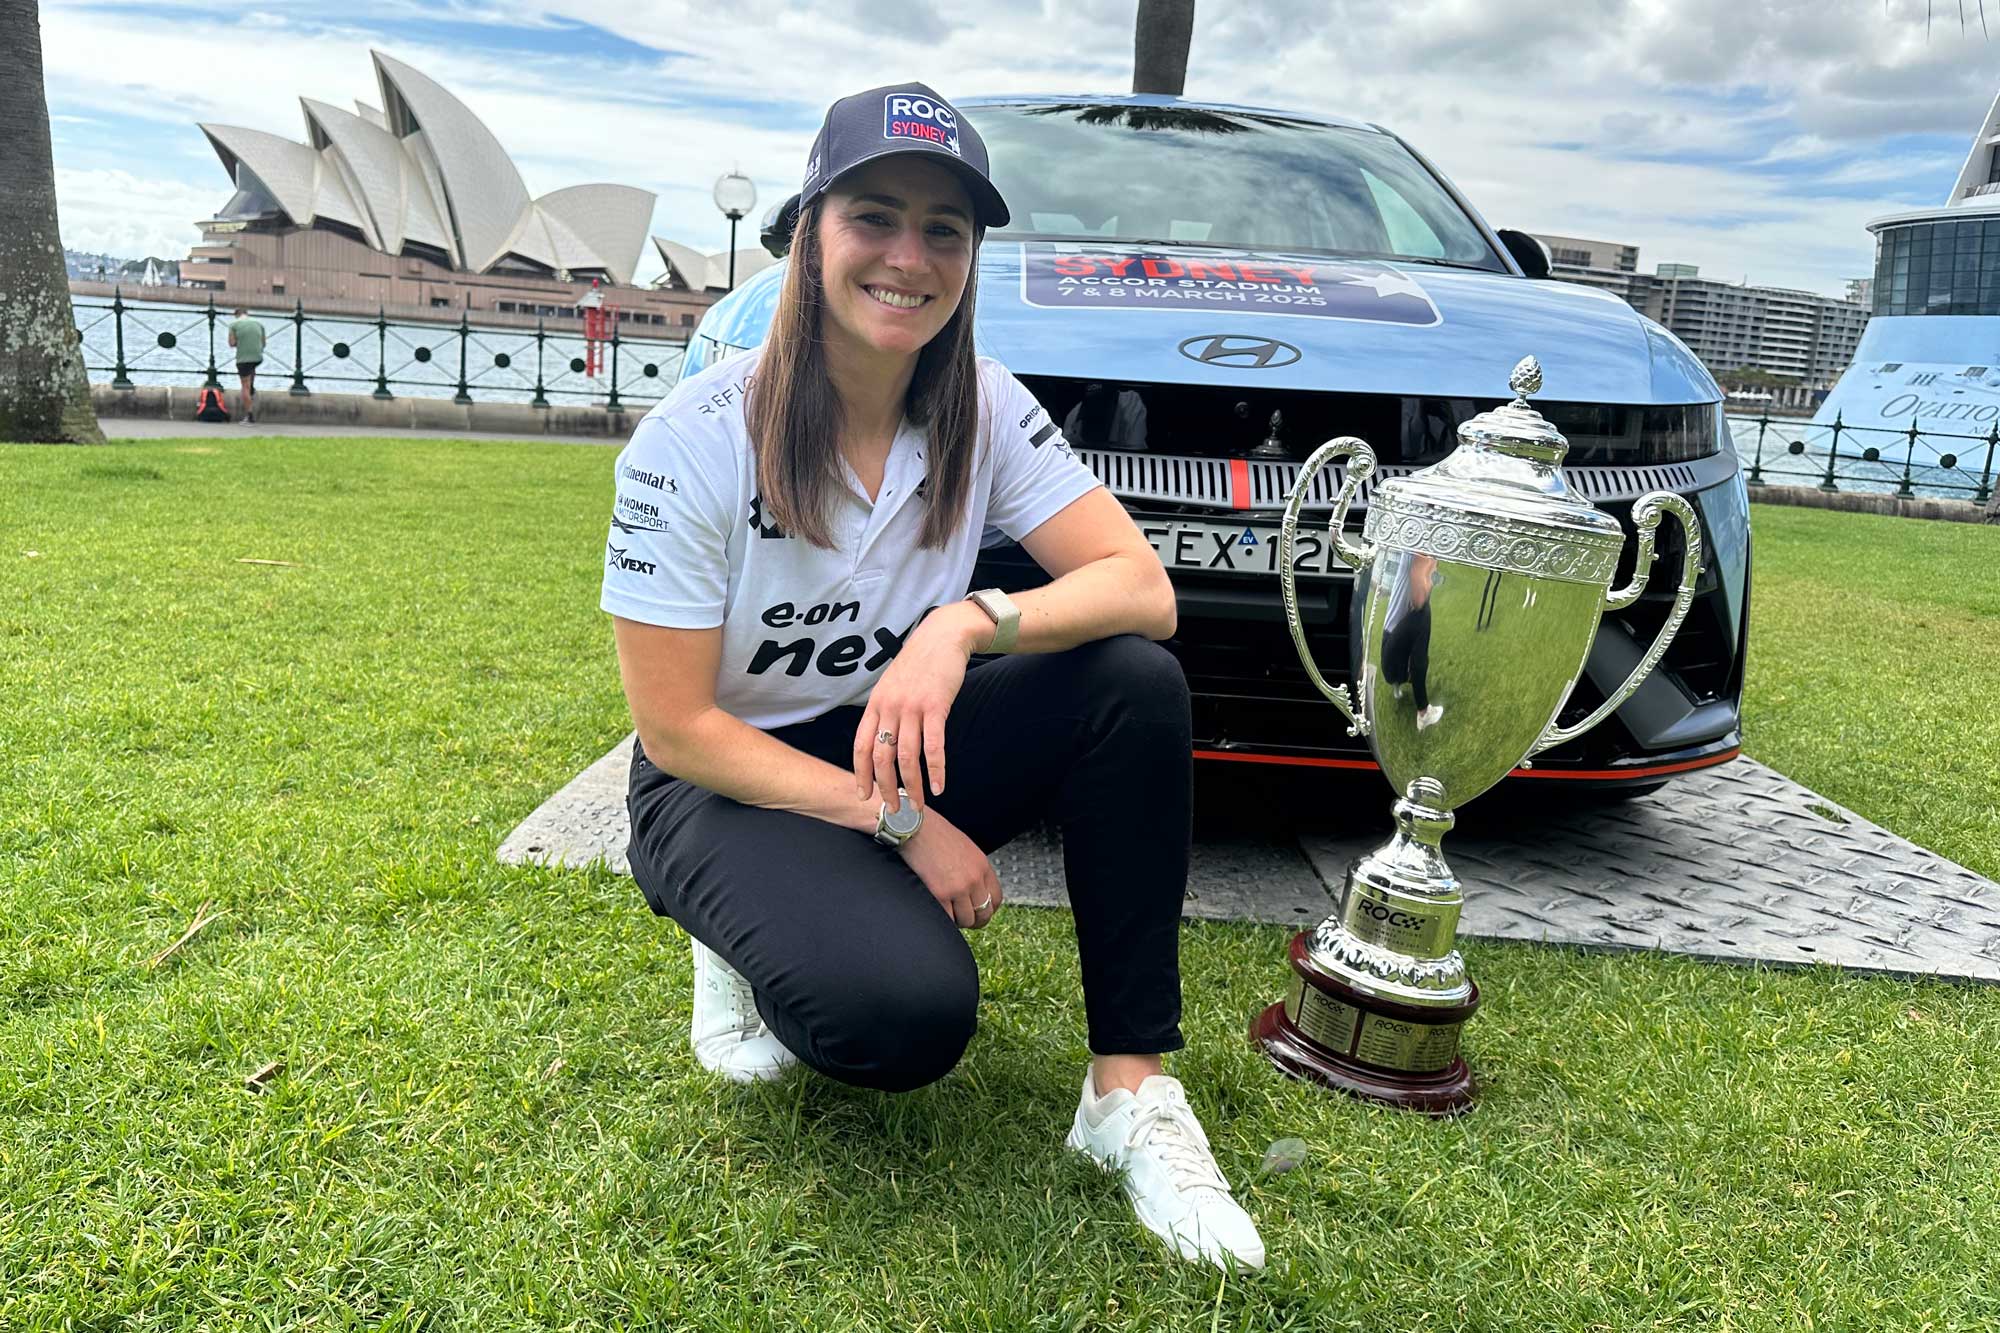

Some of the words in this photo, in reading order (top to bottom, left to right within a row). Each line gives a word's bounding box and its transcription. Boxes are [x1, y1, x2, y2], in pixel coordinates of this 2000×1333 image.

[892, 98, 952, 128] ROC
[892, 120, 946, 144] SYDNEY
[1054, 256, 1317, 285] SYDNEY
[1057, 287, 1075, 296] 7
[1083, 287, 1101, 297] &
[1109, 287, 1127, 297] 8
[1134, 288, 1247, 302] MARCH
[1254, 293, 1328, 306] 2025
[1058, 276, 1167, 287] ACCOR
[1178, 279, 1321, 295] STADIUM
[1880, 393, 1999, 421] OVATIO
[624, 496, 659, 518] WOMEN
[1242, 536, 1254, 544] EV
[620, 556, 656, 575] VEXT
[746, 614, 926, 677] nex
[1358, 899, 1407, 926] ROC
